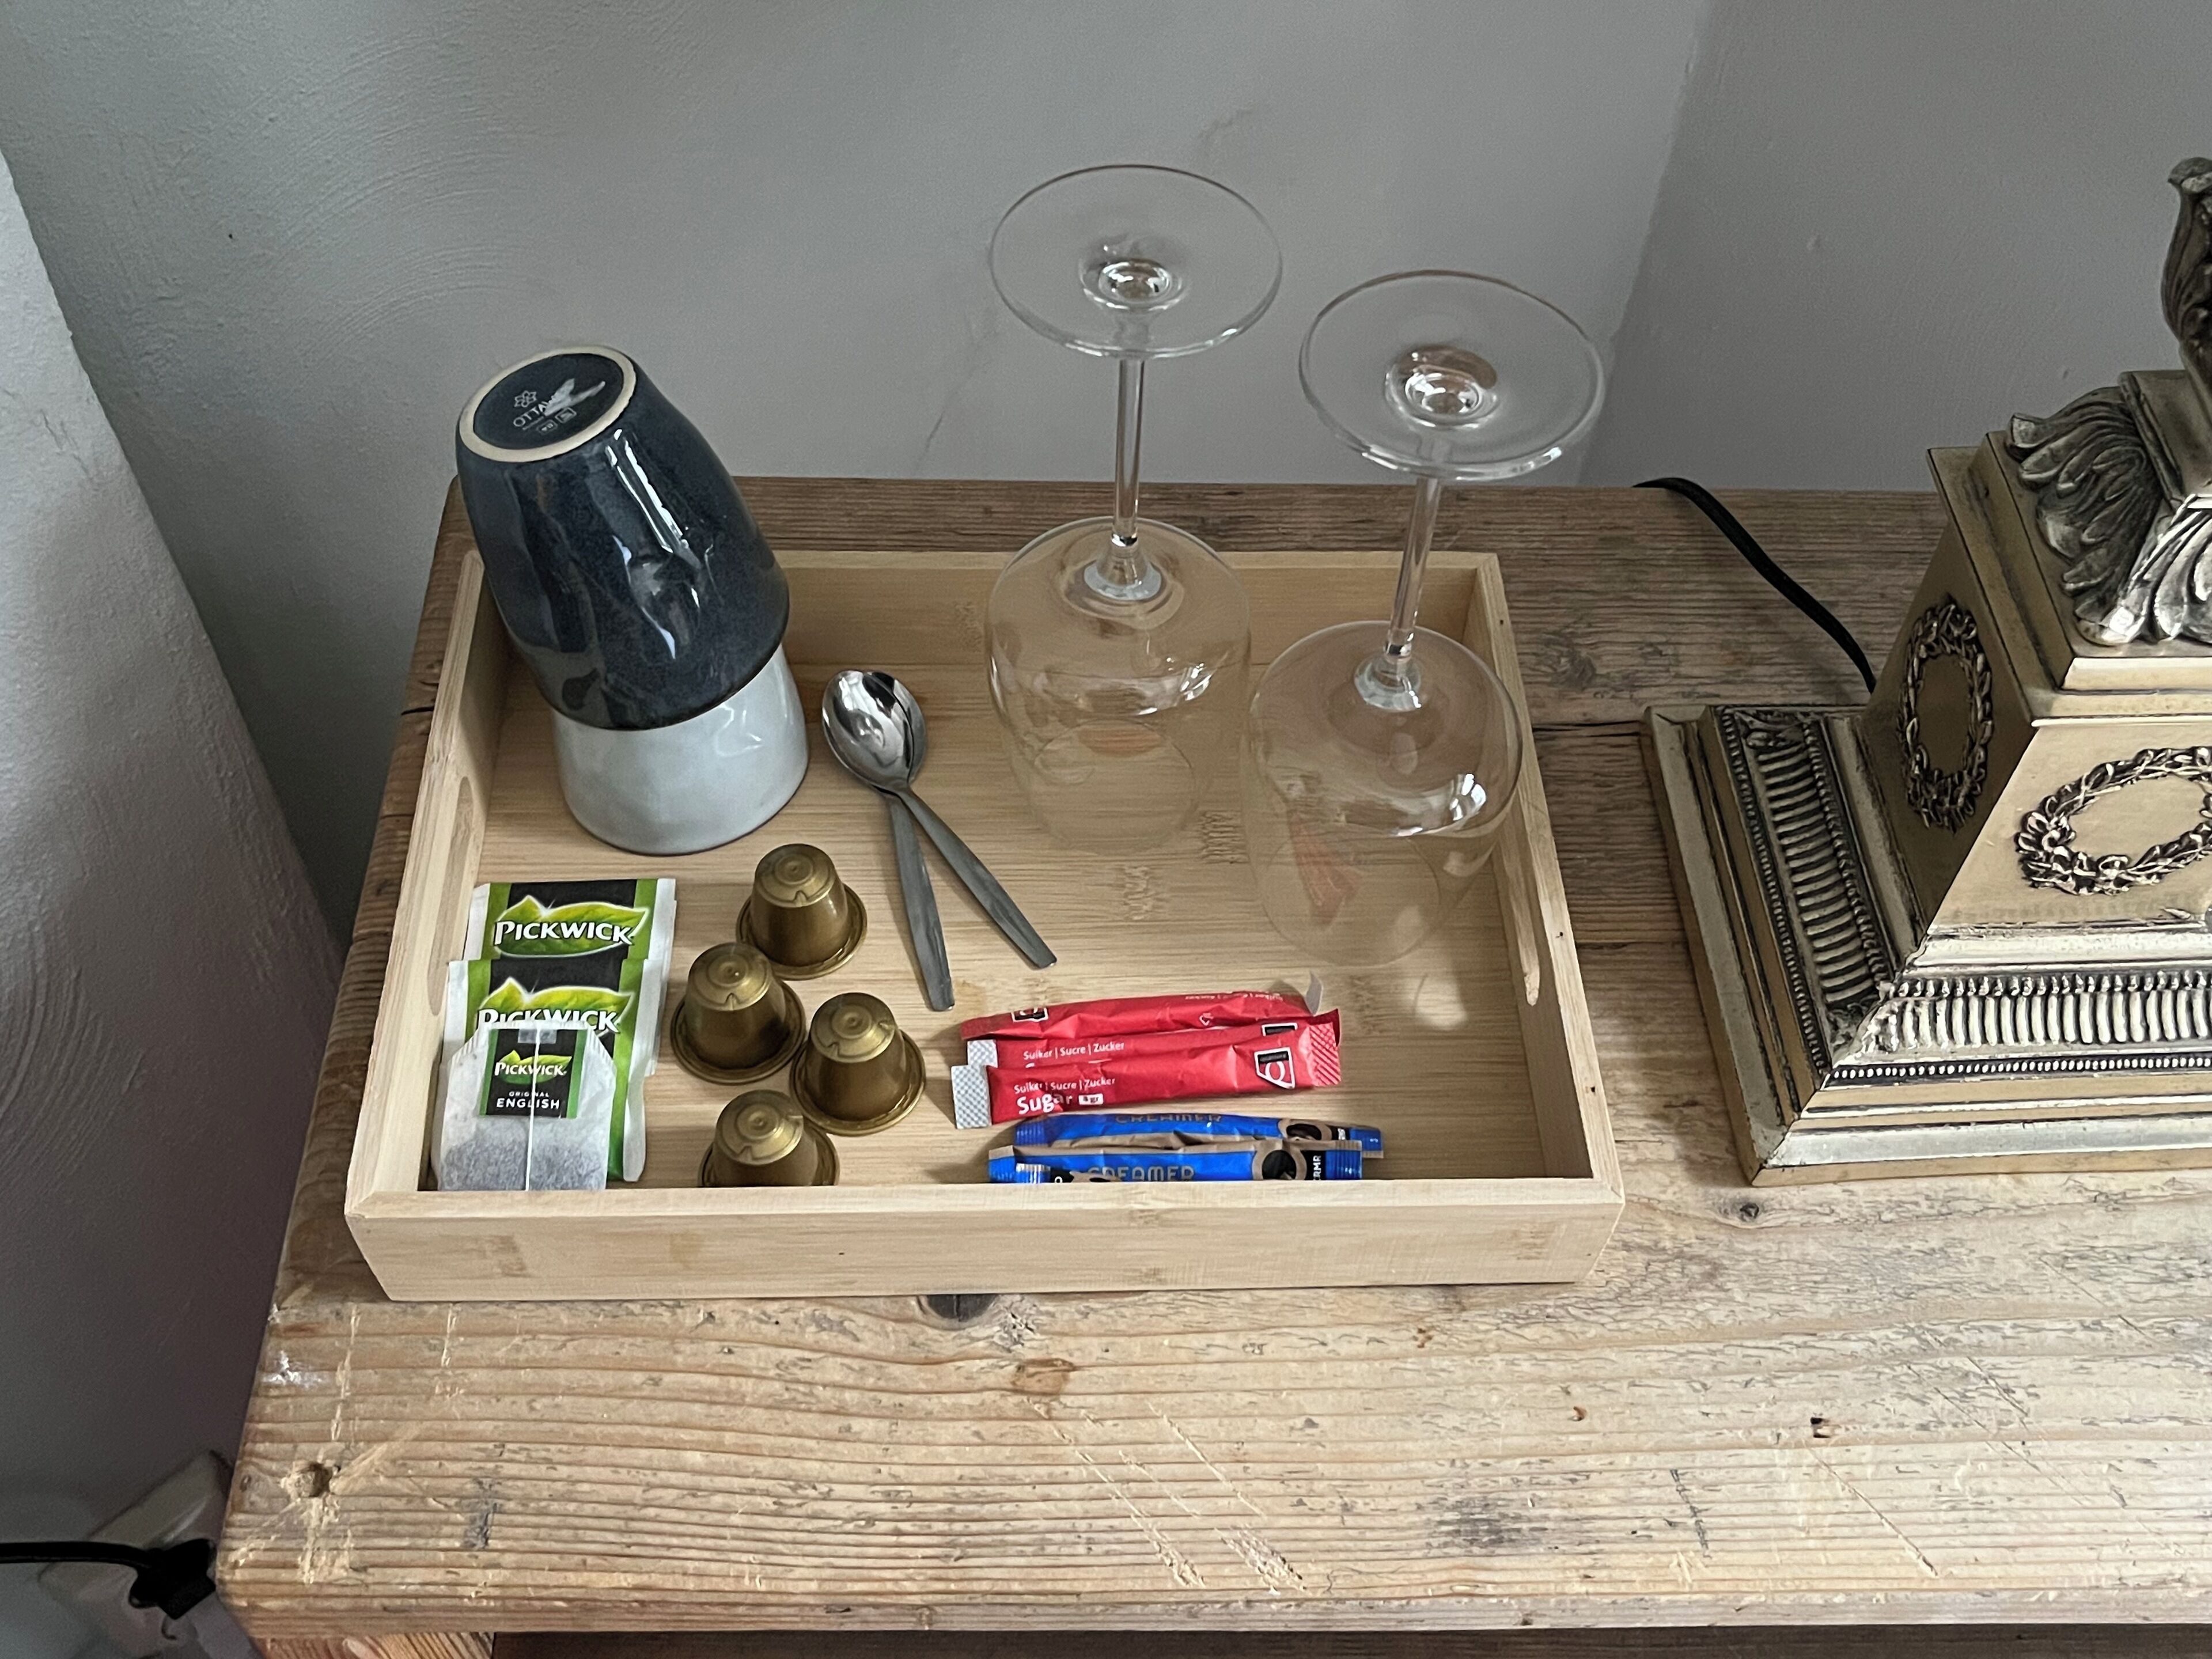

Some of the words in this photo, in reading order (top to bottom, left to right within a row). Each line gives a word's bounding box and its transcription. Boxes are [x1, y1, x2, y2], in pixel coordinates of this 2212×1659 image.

[494, 921, 632, 945] PICKWICK
[1060, 1046, 1086, 1056] Sucre
[1094, 1041, 1124, 1052] Zucker
[1050, 1082, 1077, 1090] Sucre
[1084, 1076, 1115, 1090] Zucker
[496, 1098, 560, 1110] ENGLISH
[1017, 1094, 1073, 1115] Sugar
